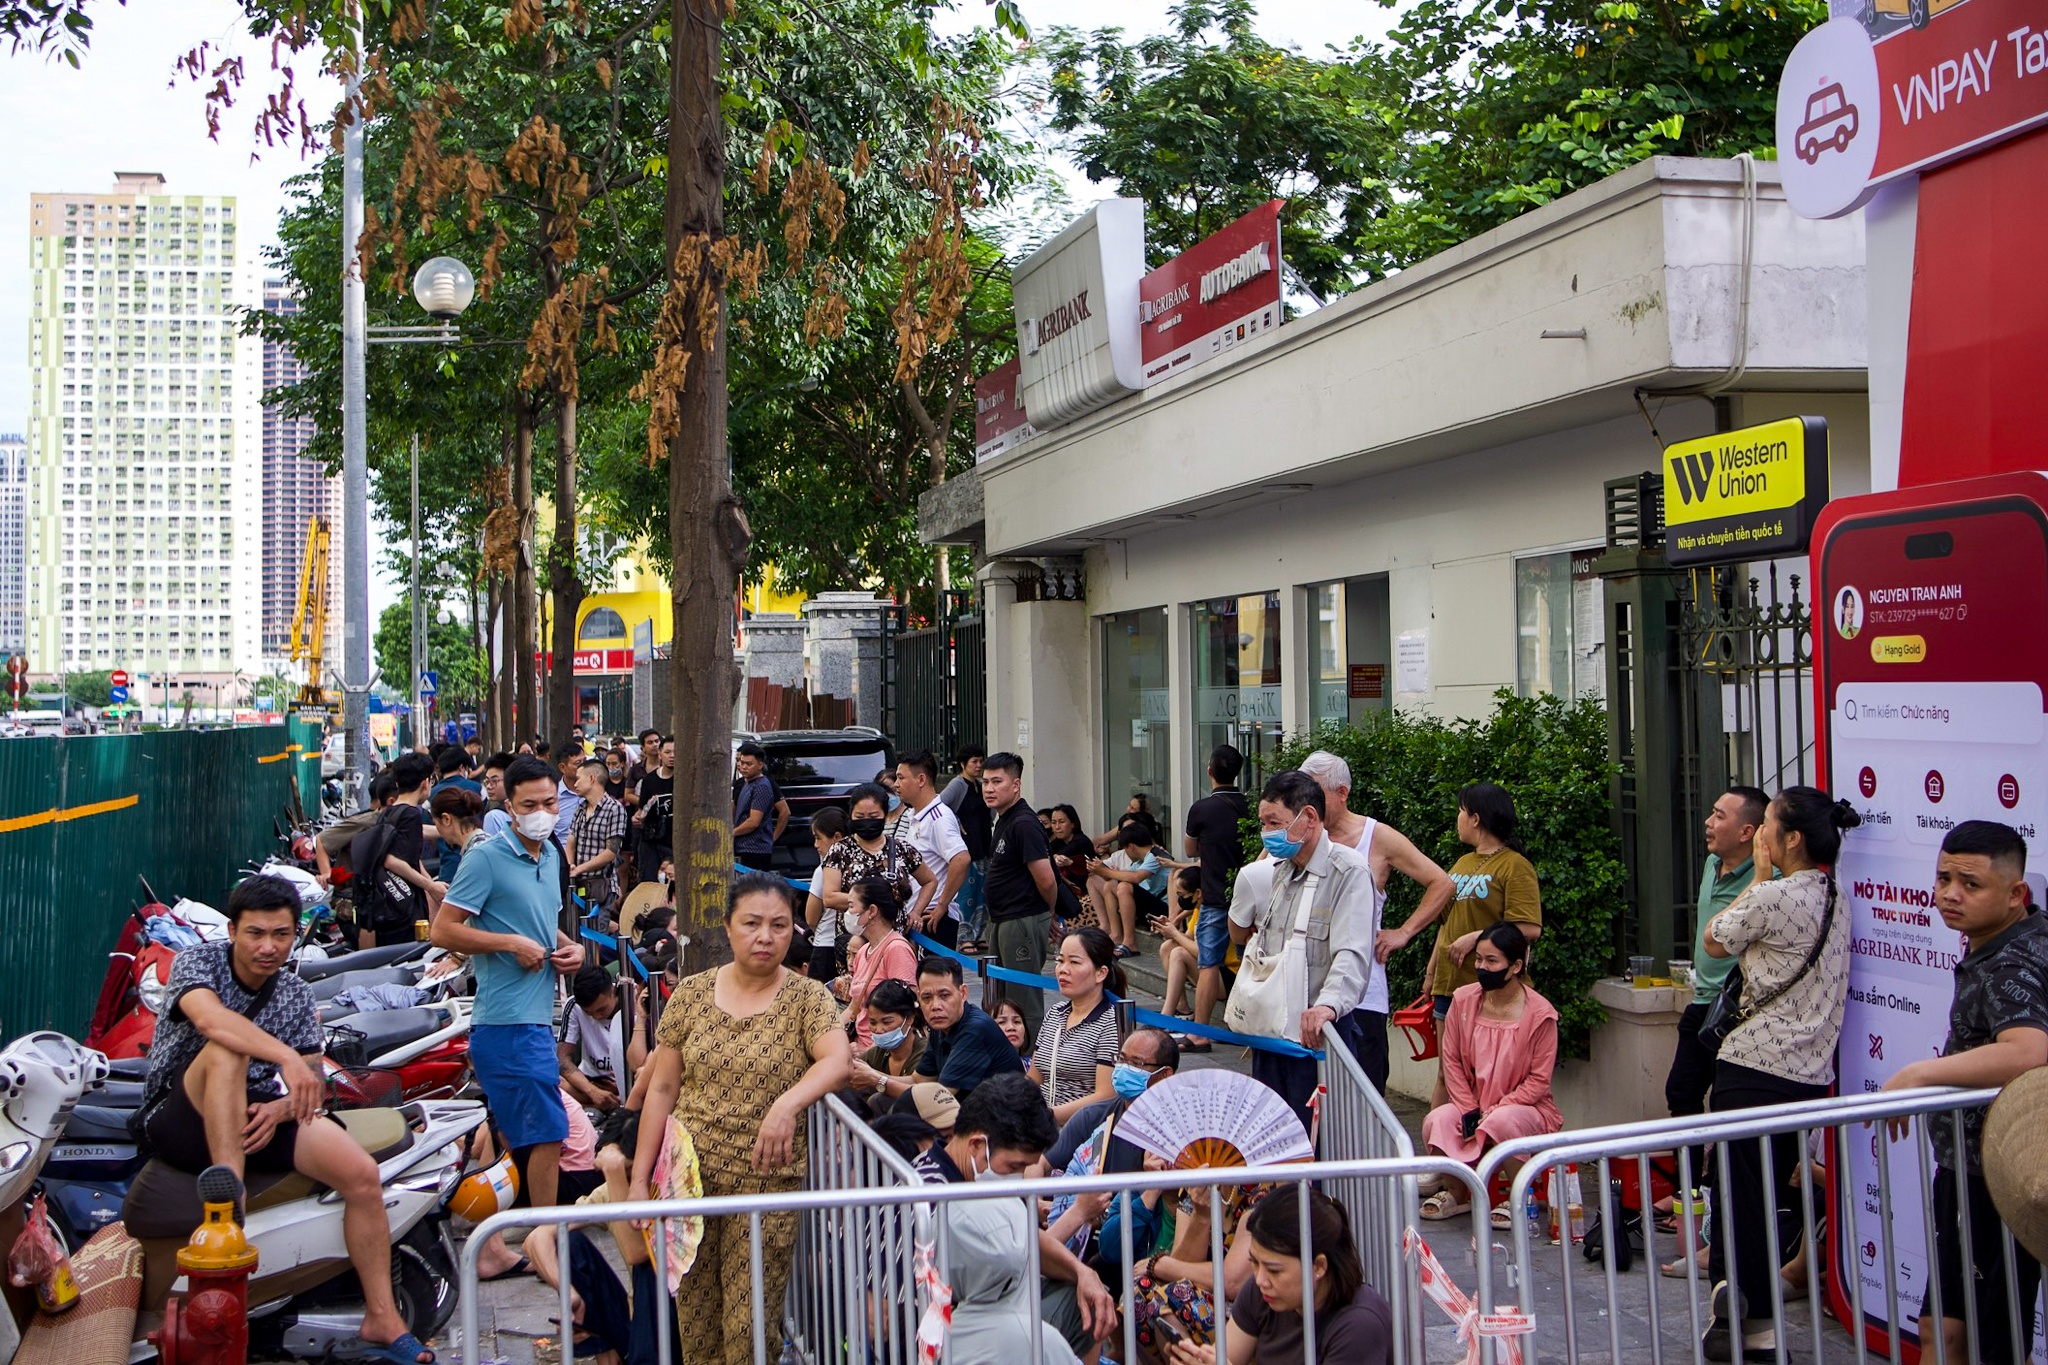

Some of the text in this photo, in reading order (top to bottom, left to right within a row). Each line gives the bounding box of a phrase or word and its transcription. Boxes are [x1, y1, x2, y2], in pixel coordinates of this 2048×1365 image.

[1893, 26, 2048, 126] VNPAY Ta
[1199, 241, 1271, 304] AUTOBANK
[1152, 282, 1190, 318] AGRIBANK
[1037, 290, 1092, 347] AGRIBANK
[1719, 441, 1787, 472] Western
[1719, 471, 1767, 498] Union
[1677, 520, 1783, 550] Nhận và chuyển tiền quốc tế
[1869, 584, 1962, 604] NGUYEN TRAN ANH
[1869, 610, 1886, 623] STK:
[1884, 644, 1921, 657] Hạng Gold
[1878, 704, 1899, 719] kiếm
[1900, 704, 1925, 719] Chức
[1926, 705, 1949, 723] năng
[1916, 815, 1955, 830] Tài khoản
[1854, 878, 1875, 899] MỞ
[1876, 881, 1898, 902] TÀI
[1871, 907, 1931, 927] TRỰC TUYẾN
[1872, 928, 1888, 938] ngay
[1850, 937, 1958, 971] AGRIBANK PLUS
[1866, 985, 1887, 1007] sắm
[1888, 994, 1921, 1014] Online
[590, 1055, 613, 1071] adi
[63, 1148, 115, 1156] HONDA
